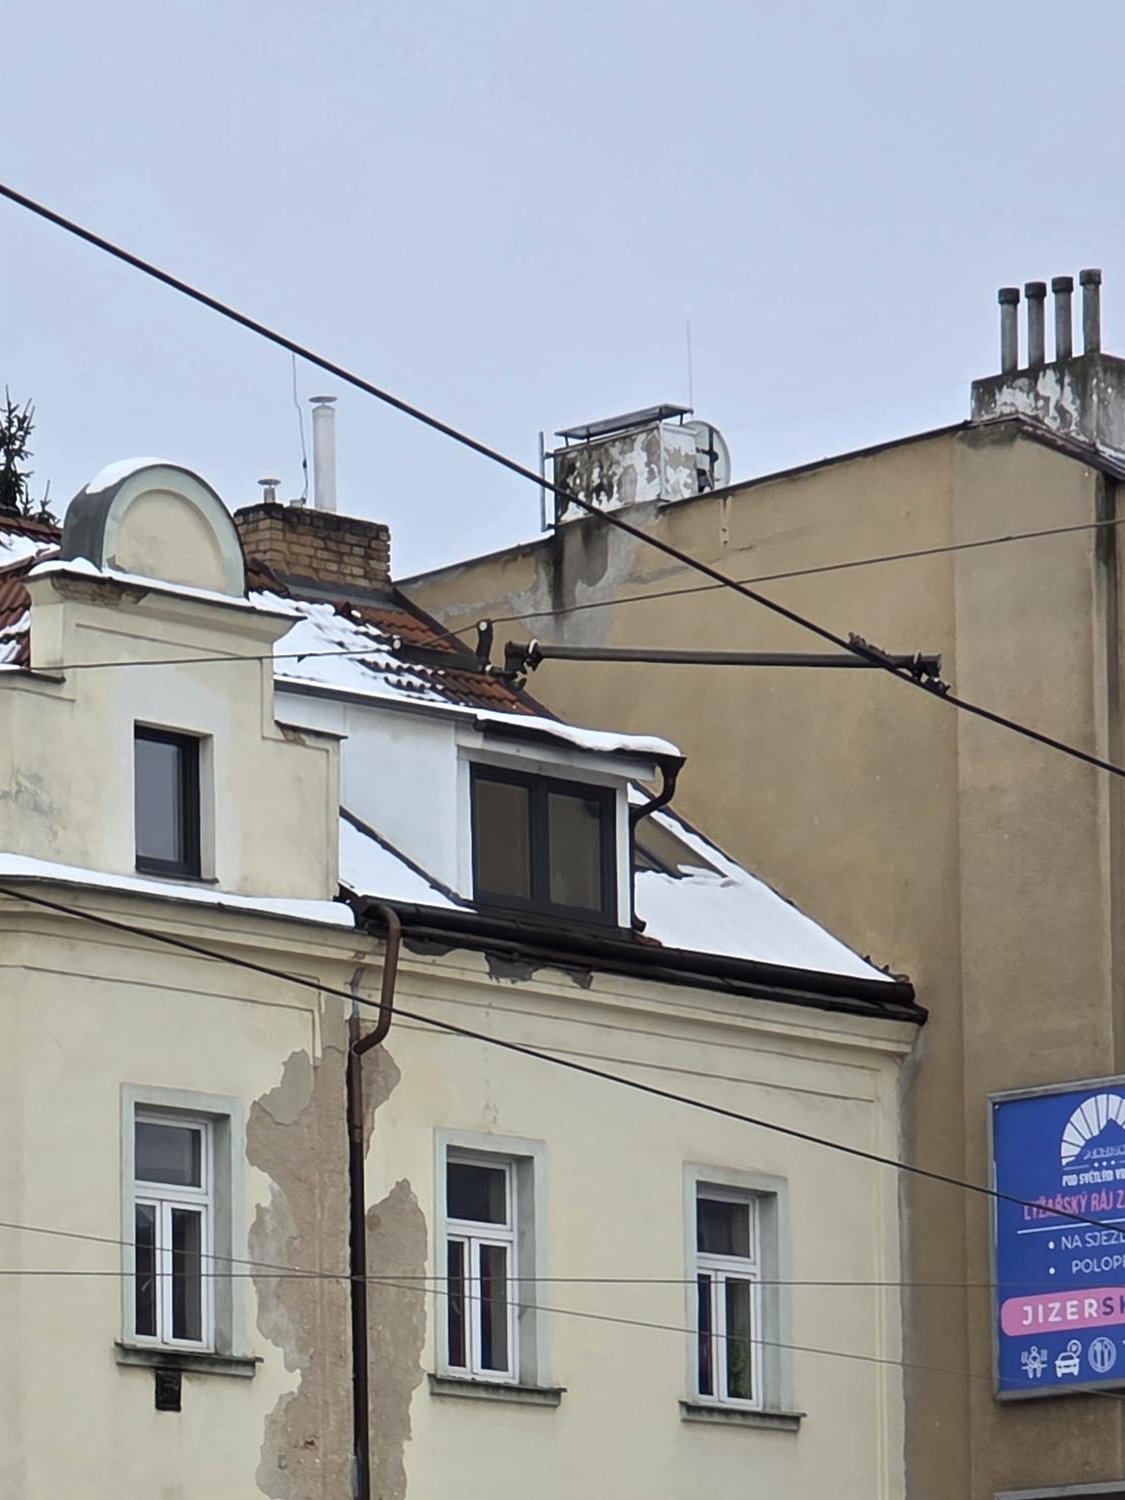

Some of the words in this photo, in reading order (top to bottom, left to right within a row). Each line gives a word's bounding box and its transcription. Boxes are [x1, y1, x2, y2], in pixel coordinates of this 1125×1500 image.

[1090, 1188, 1113, 1212] RÁJ
[1061, 1234, 1083, 1250] NA
[1071, 1254, 1125, 1274] POLOP
